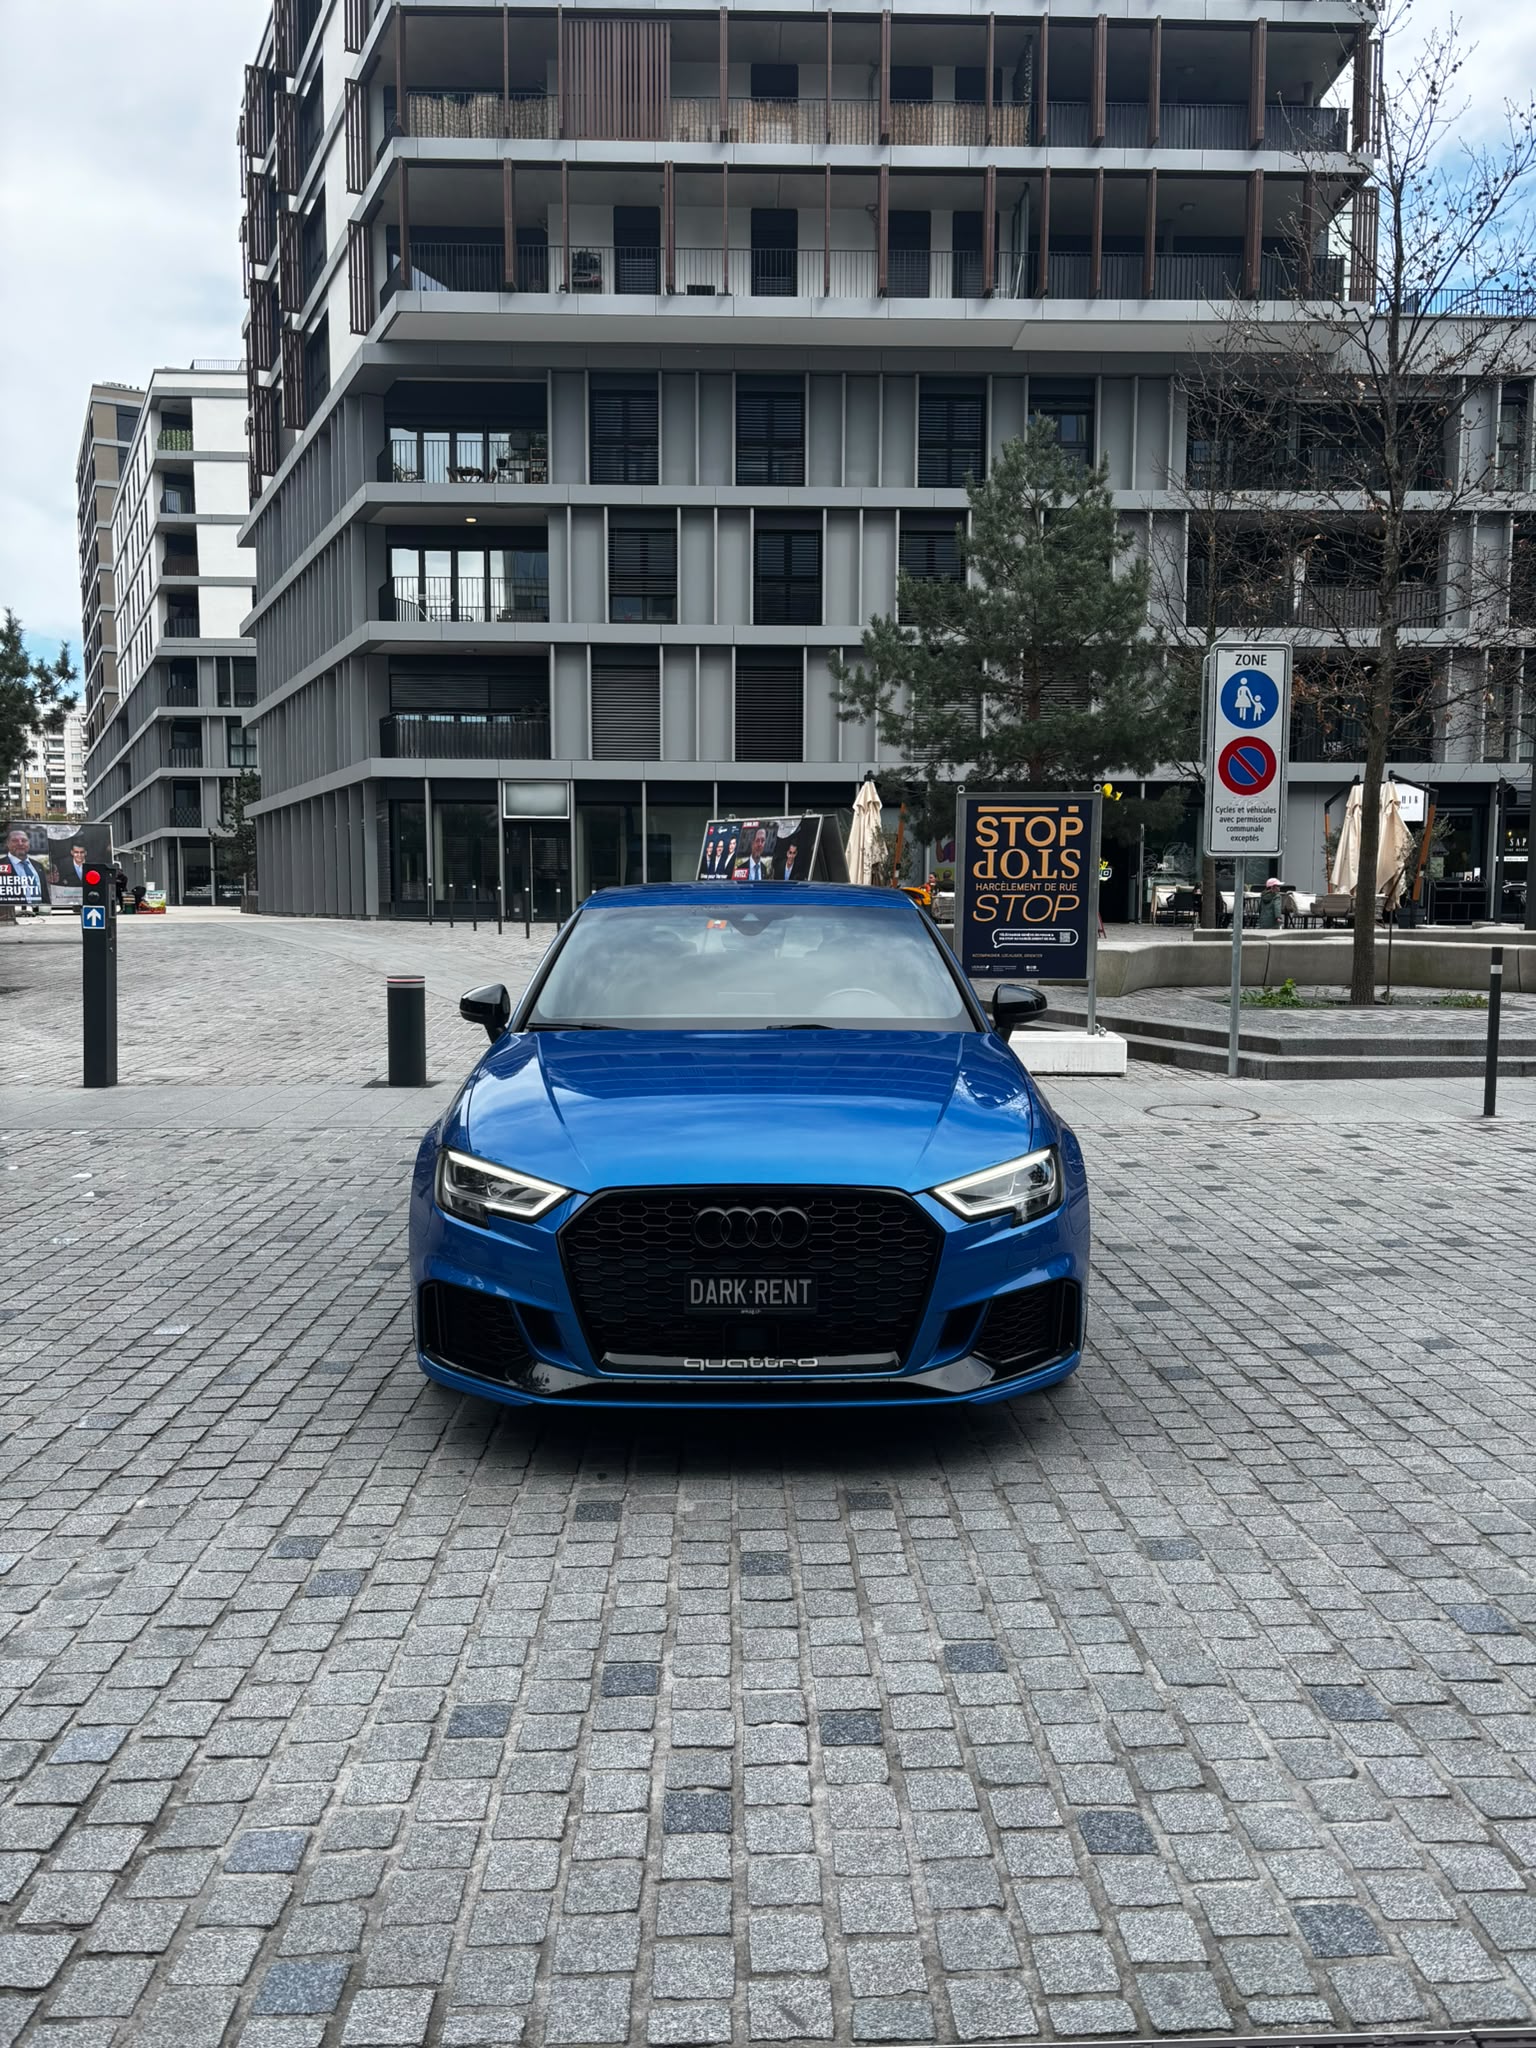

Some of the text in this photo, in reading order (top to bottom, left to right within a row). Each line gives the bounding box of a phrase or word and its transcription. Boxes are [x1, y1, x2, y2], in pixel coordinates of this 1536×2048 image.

[1235, 654, 1267, 666] ZONE
[1215, 805, 1277, 815] Cycles et véhicules
[1236, 815, 1272, 825] permission
[975, 816, 1084, 847] STOP
[1226, 825, 1264, 833] communale
[1230, 834, 1260, 843] exceptés
[975, 880, 1078, 891] HARCÈLEMENT DE RUE
[972, 894, 1080, 922] STOP
[683, 1356, 818, 1371] quattro
